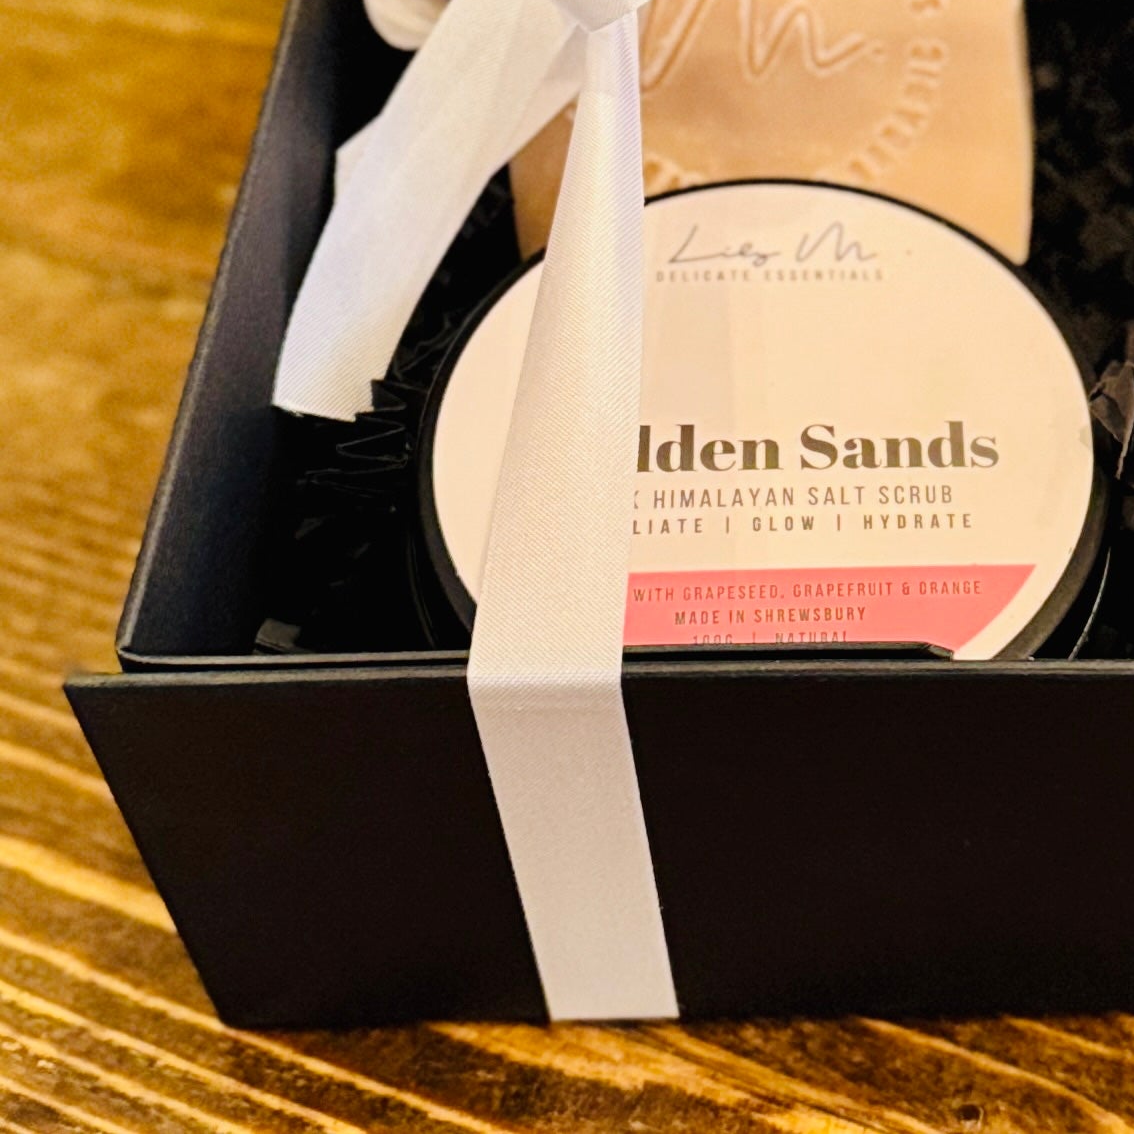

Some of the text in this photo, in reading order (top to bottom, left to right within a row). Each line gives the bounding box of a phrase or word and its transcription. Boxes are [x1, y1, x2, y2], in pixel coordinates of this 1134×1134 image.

[656, 268, 884, 283] DELICATE ESSENTIALS
[636, 420, 1000, 473] lden Sands
[652, 487, 796, 509] HIMALAYAN
[807, 485, 866, 506] SALT
[878, 484, 953, 505] SCRUB
[752, 514, 815, 533] GLOW
[863, 512, 973, 531] HYDRATE
[633, 587, 675, 603] WITH
[792, 581, 894, 599] GRAPEFRUIT
[901, 580, 911, 597] &
[918, 579, 983, 596] ORANGE
[674, 605, 867, 626] MADE IN SHREWSBURY
